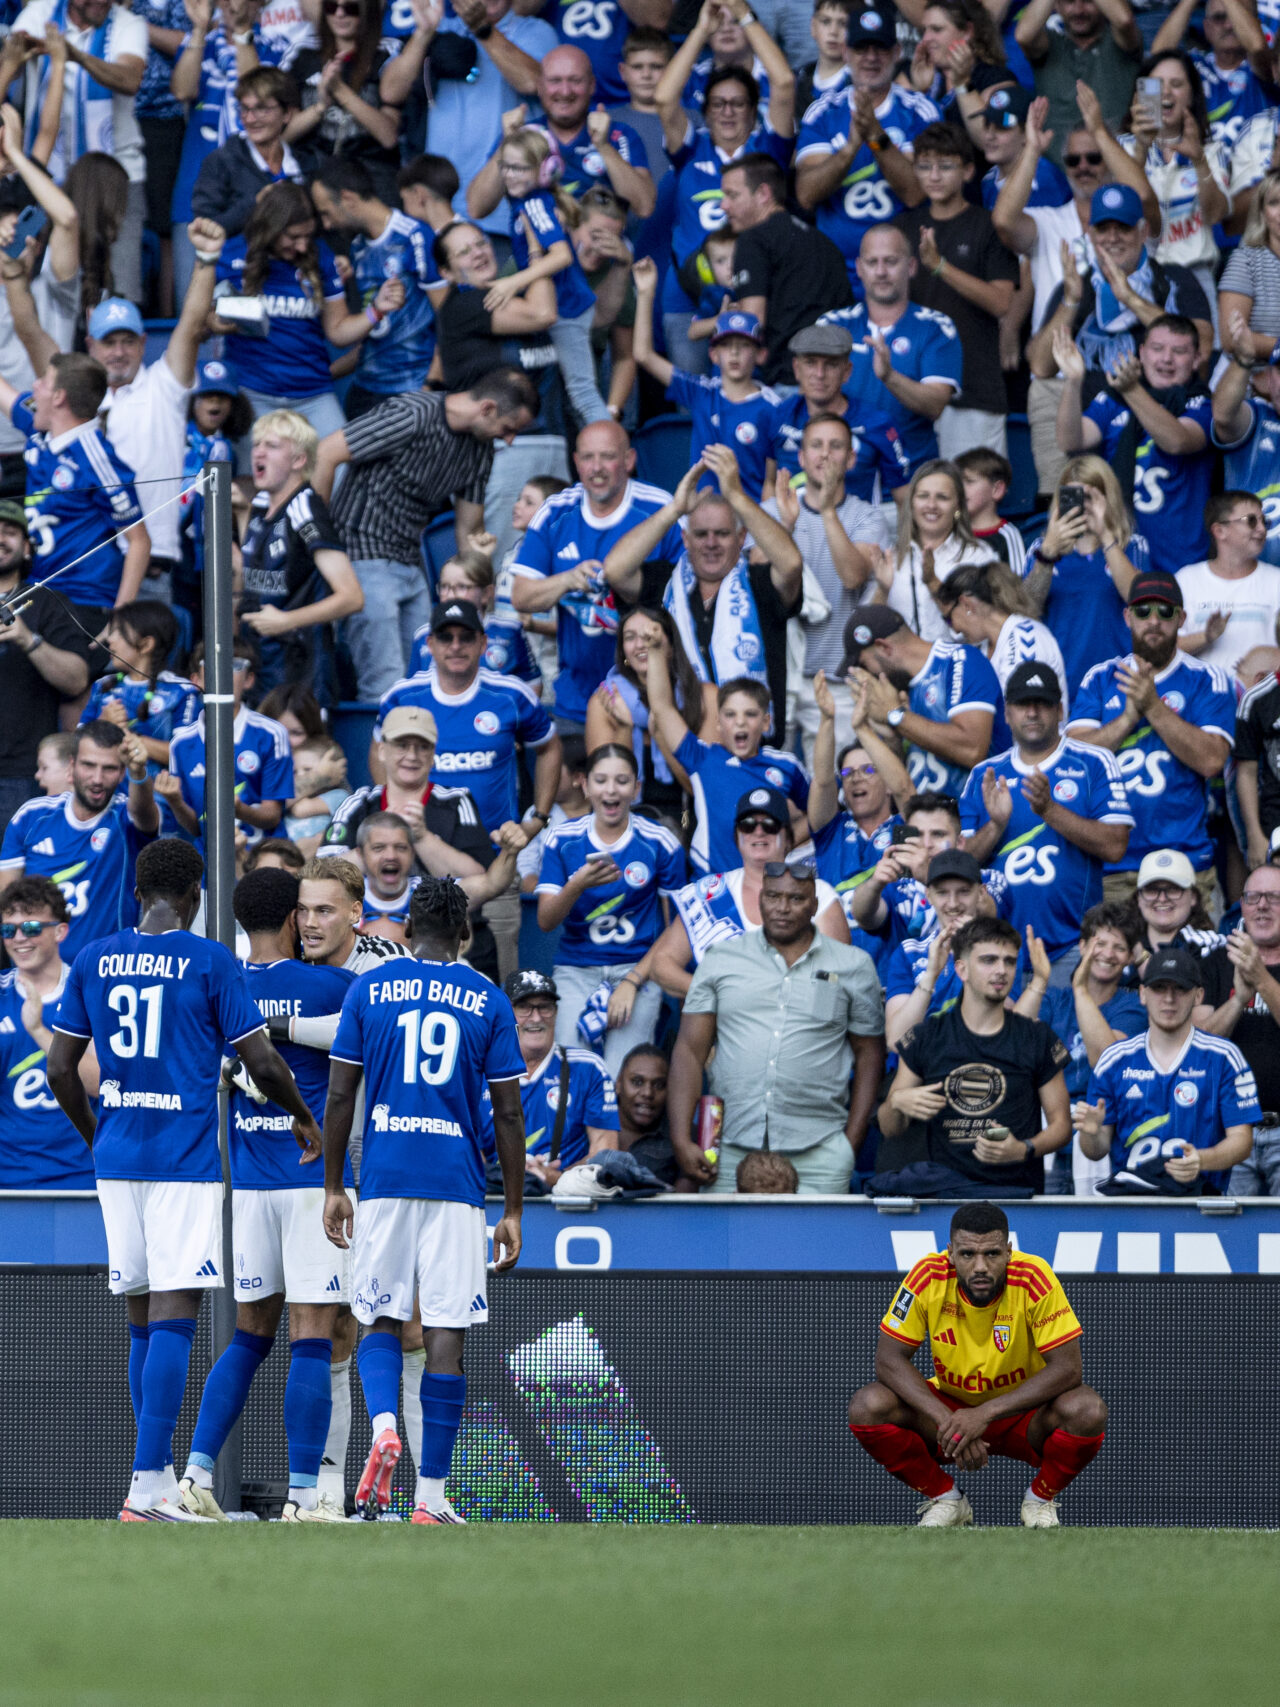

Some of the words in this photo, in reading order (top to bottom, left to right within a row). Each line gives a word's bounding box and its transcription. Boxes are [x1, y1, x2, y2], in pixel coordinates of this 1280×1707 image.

[562, 0, 617, 39] es
[844, 179, 893, 219] es
[1004, 844, 1059, 885] es
[588, 911, 636, 945] es
[98, 953, 190, 980] COULIBALY
[369, 978, 423, 1005] FABIO
[427, 980, 488, 1017] BALDÉ
[108, 984, 165, 1059] 31
[397, 1009, 461, 1086] 19
[122, 1091, 182, 1111] SOPREMA
[244, 1114, 296, 1132] OPREM
[389, 1116, 463, 1138] SOPREMA
[972, 1118, 984, 1128] EN
